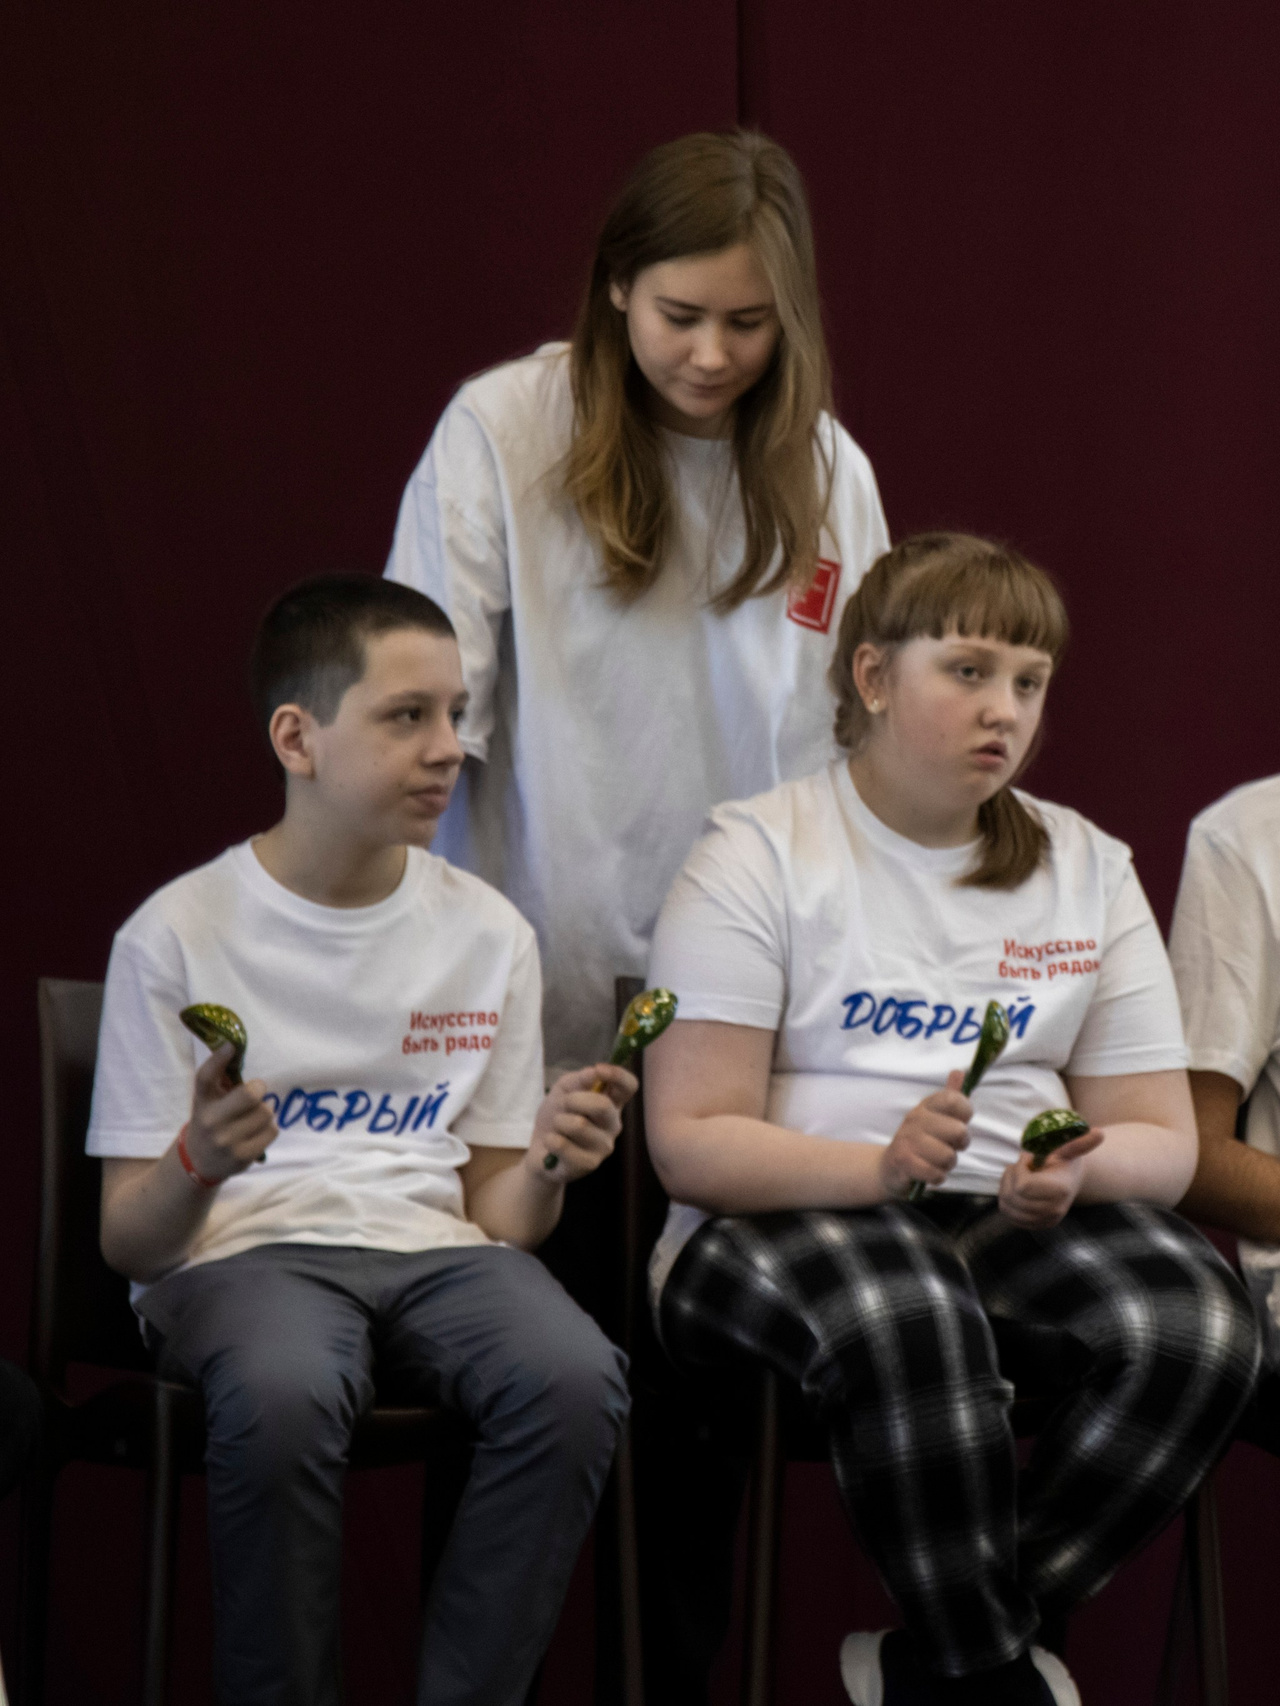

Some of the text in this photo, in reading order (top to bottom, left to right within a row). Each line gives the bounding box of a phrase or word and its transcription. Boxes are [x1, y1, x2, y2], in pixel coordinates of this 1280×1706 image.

[1003, 938, 1097, 962] Искусство
[998, 961, 1042, 981] быть
[409, 1010, 499, 1034] Искусство
[402, 1034, 492, 1056] быть рядо
